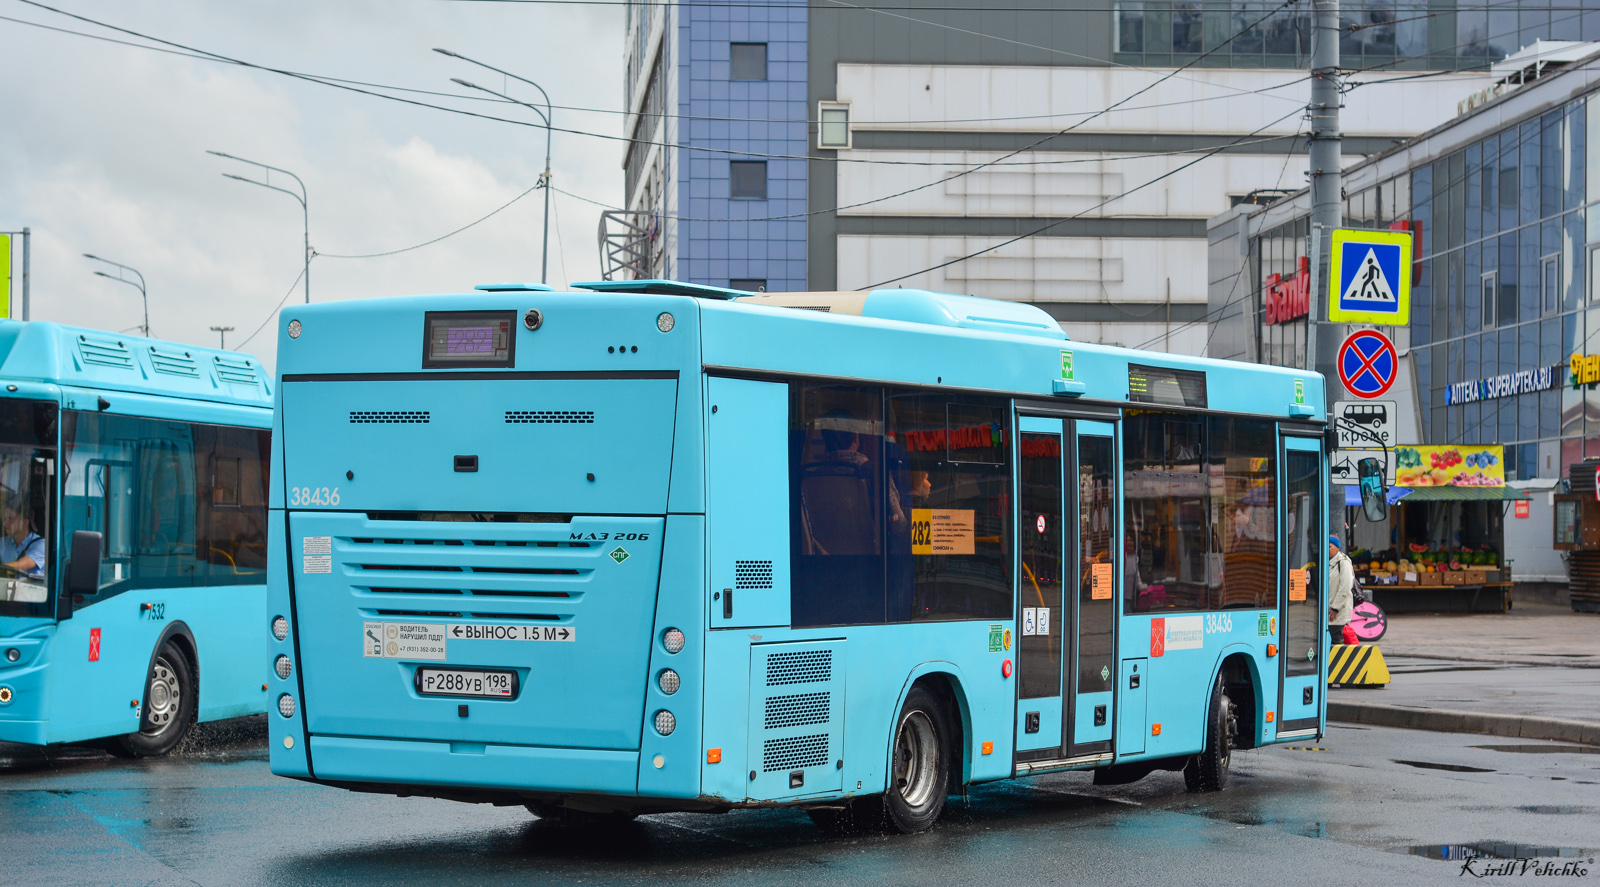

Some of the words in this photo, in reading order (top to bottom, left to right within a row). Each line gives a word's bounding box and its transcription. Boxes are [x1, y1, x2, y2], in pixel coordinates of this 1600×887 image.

[1487, 366, 1553, 399] SUPERAPTEKA.RU
[1451, 381, 1479, 404] АПТЕКА
[1341, 431, 1389, 446] кроме
[291, 487, 340, 506] 38436
[569, 532, 609, 540] МАЗ
[614, 533, 649, 541] 206
[912, 521, 931, 545] 282
[400, 625, 429, 633] ВОДИТЕЛЬ
[1206, 613, 1232, 633] 38436
[428, 634, 444, 642] ПДД?
[465, 625, 518, 640] ВЫНОС
[522, 626, 541, 640] 1.5
[486, 674, 507, 688] 198
